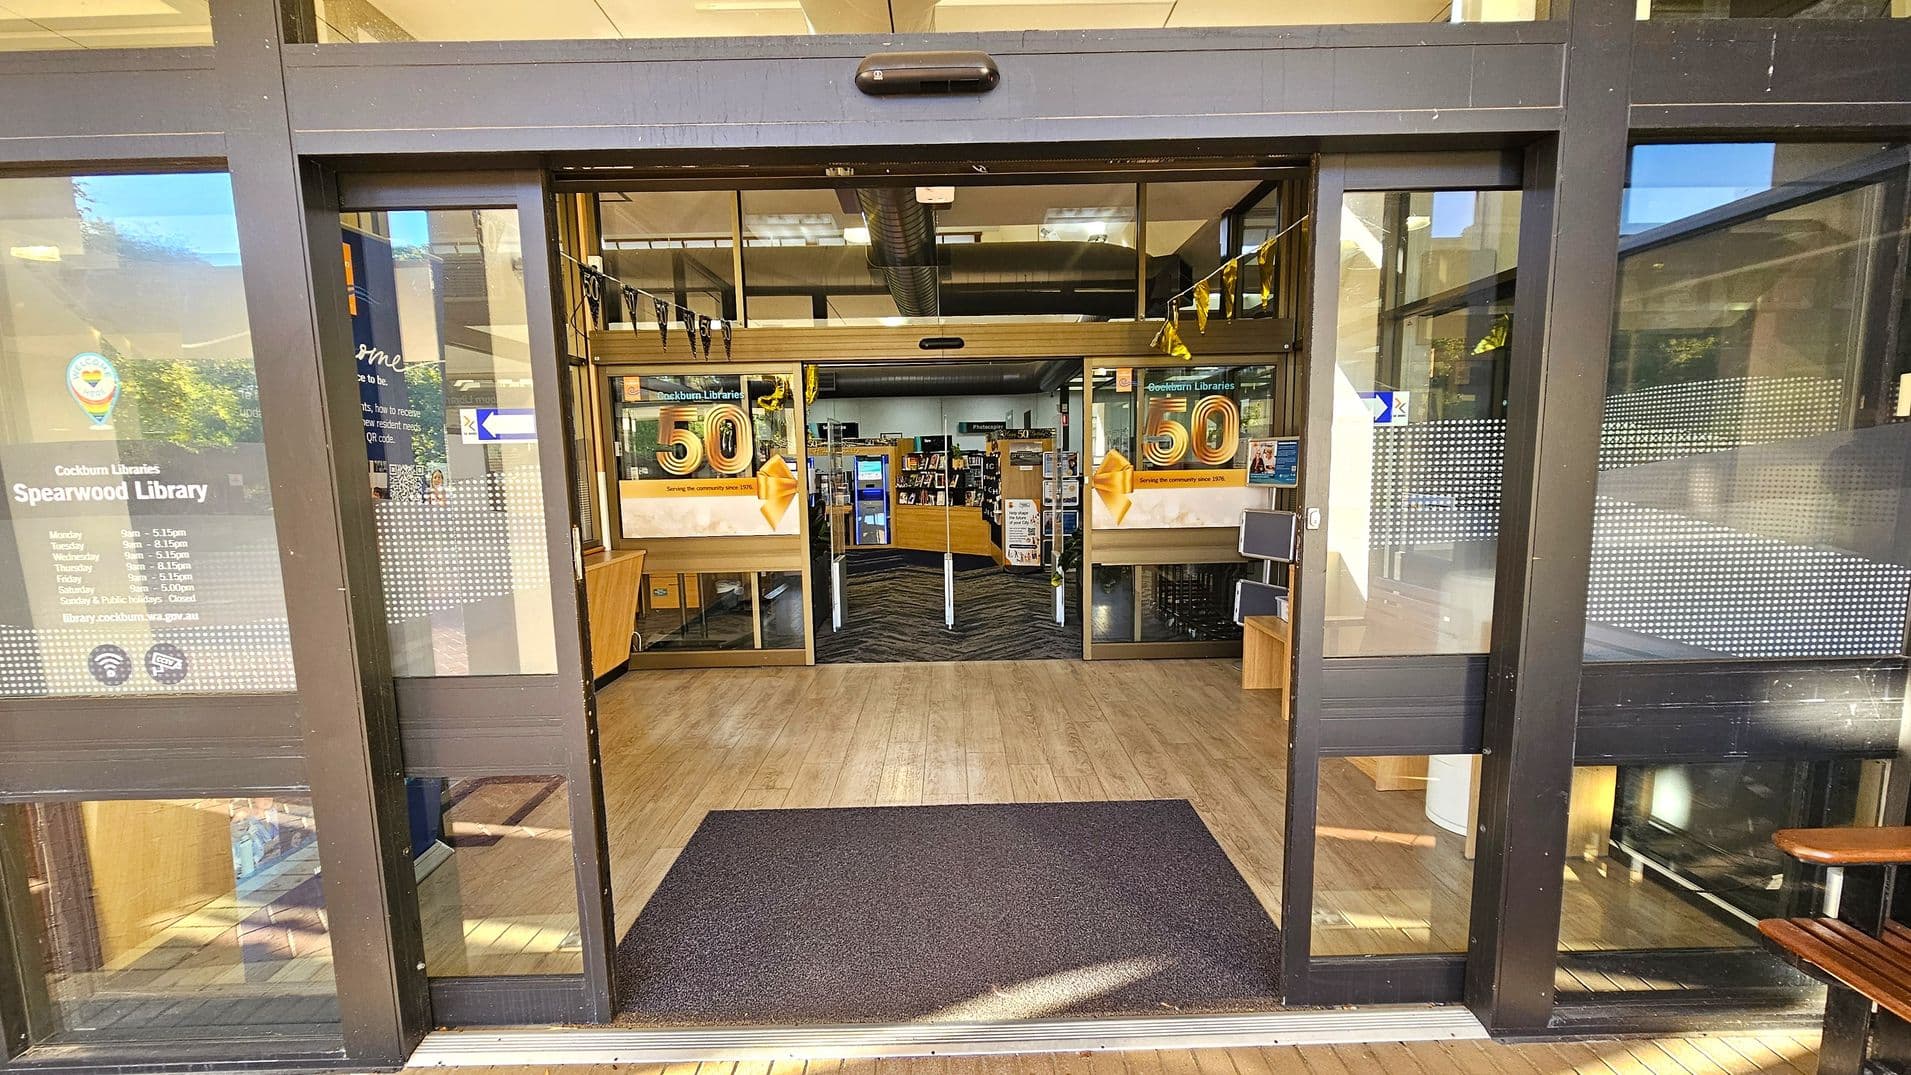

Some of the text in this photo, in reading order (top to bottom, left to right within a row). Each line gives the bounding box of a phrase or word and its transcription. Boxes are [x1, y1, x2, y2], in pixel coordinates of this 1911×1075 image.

[71, 358, 111, 380] WELCOME
[367, 375, 376, 384] to
[376, 375, 389, 386] be.
[1147, 382, 1236, 392] Cockburn Libraries
[656, 389, 745, 401] Cockburn Libraries
[374, 403, 388, 414] how
[389, 405, 397, 415] to
[397, 408, 421, 418] receive
[376, 419, 402, 431] resident
[403, 423, 422, 432] needs
[1142, 394, 1241, 467] 50
[366, 432, 397, 444] QR code.
[656, 403, 754, 476] 50
[54, 463, 161, 477] Cockburn Libraries
[12, 480, 208, 507] Spearwood Library
[48, 530, 83, 541] Monday
[120, 529, 141, 538] 9am
[152, 528, 187, 539] 5.15pm
[50, 541, 85, 552] Tuesday
[122, 540, 143, 549] 9am
[153, 539, 189, 549] 8.15pm
[52, 552, 100, 562] Wednesday
[124, 551, 144, 560] 9am
[155, 550, 190, 560] 5.15pm
[54, 563, 93, 573] Thursday
[126, 562, 146, 571] 9am
[157, 561, 192, 572] 8.15pm
[56, 574, 82, 585] Friday
[127, 573, 148, 582] 9am
[159, 572, 193, 583] 5.15pm
[58, 585, 95, 596] Saturday
[129, 584, 149, 593] 9am
[160, 583, 195, 594] 5.00pm
[60, 594, 197, 606] Sunday & Public holidays Closed
[62, 612, 199, 624] library.cockburn.wa.gov.au
